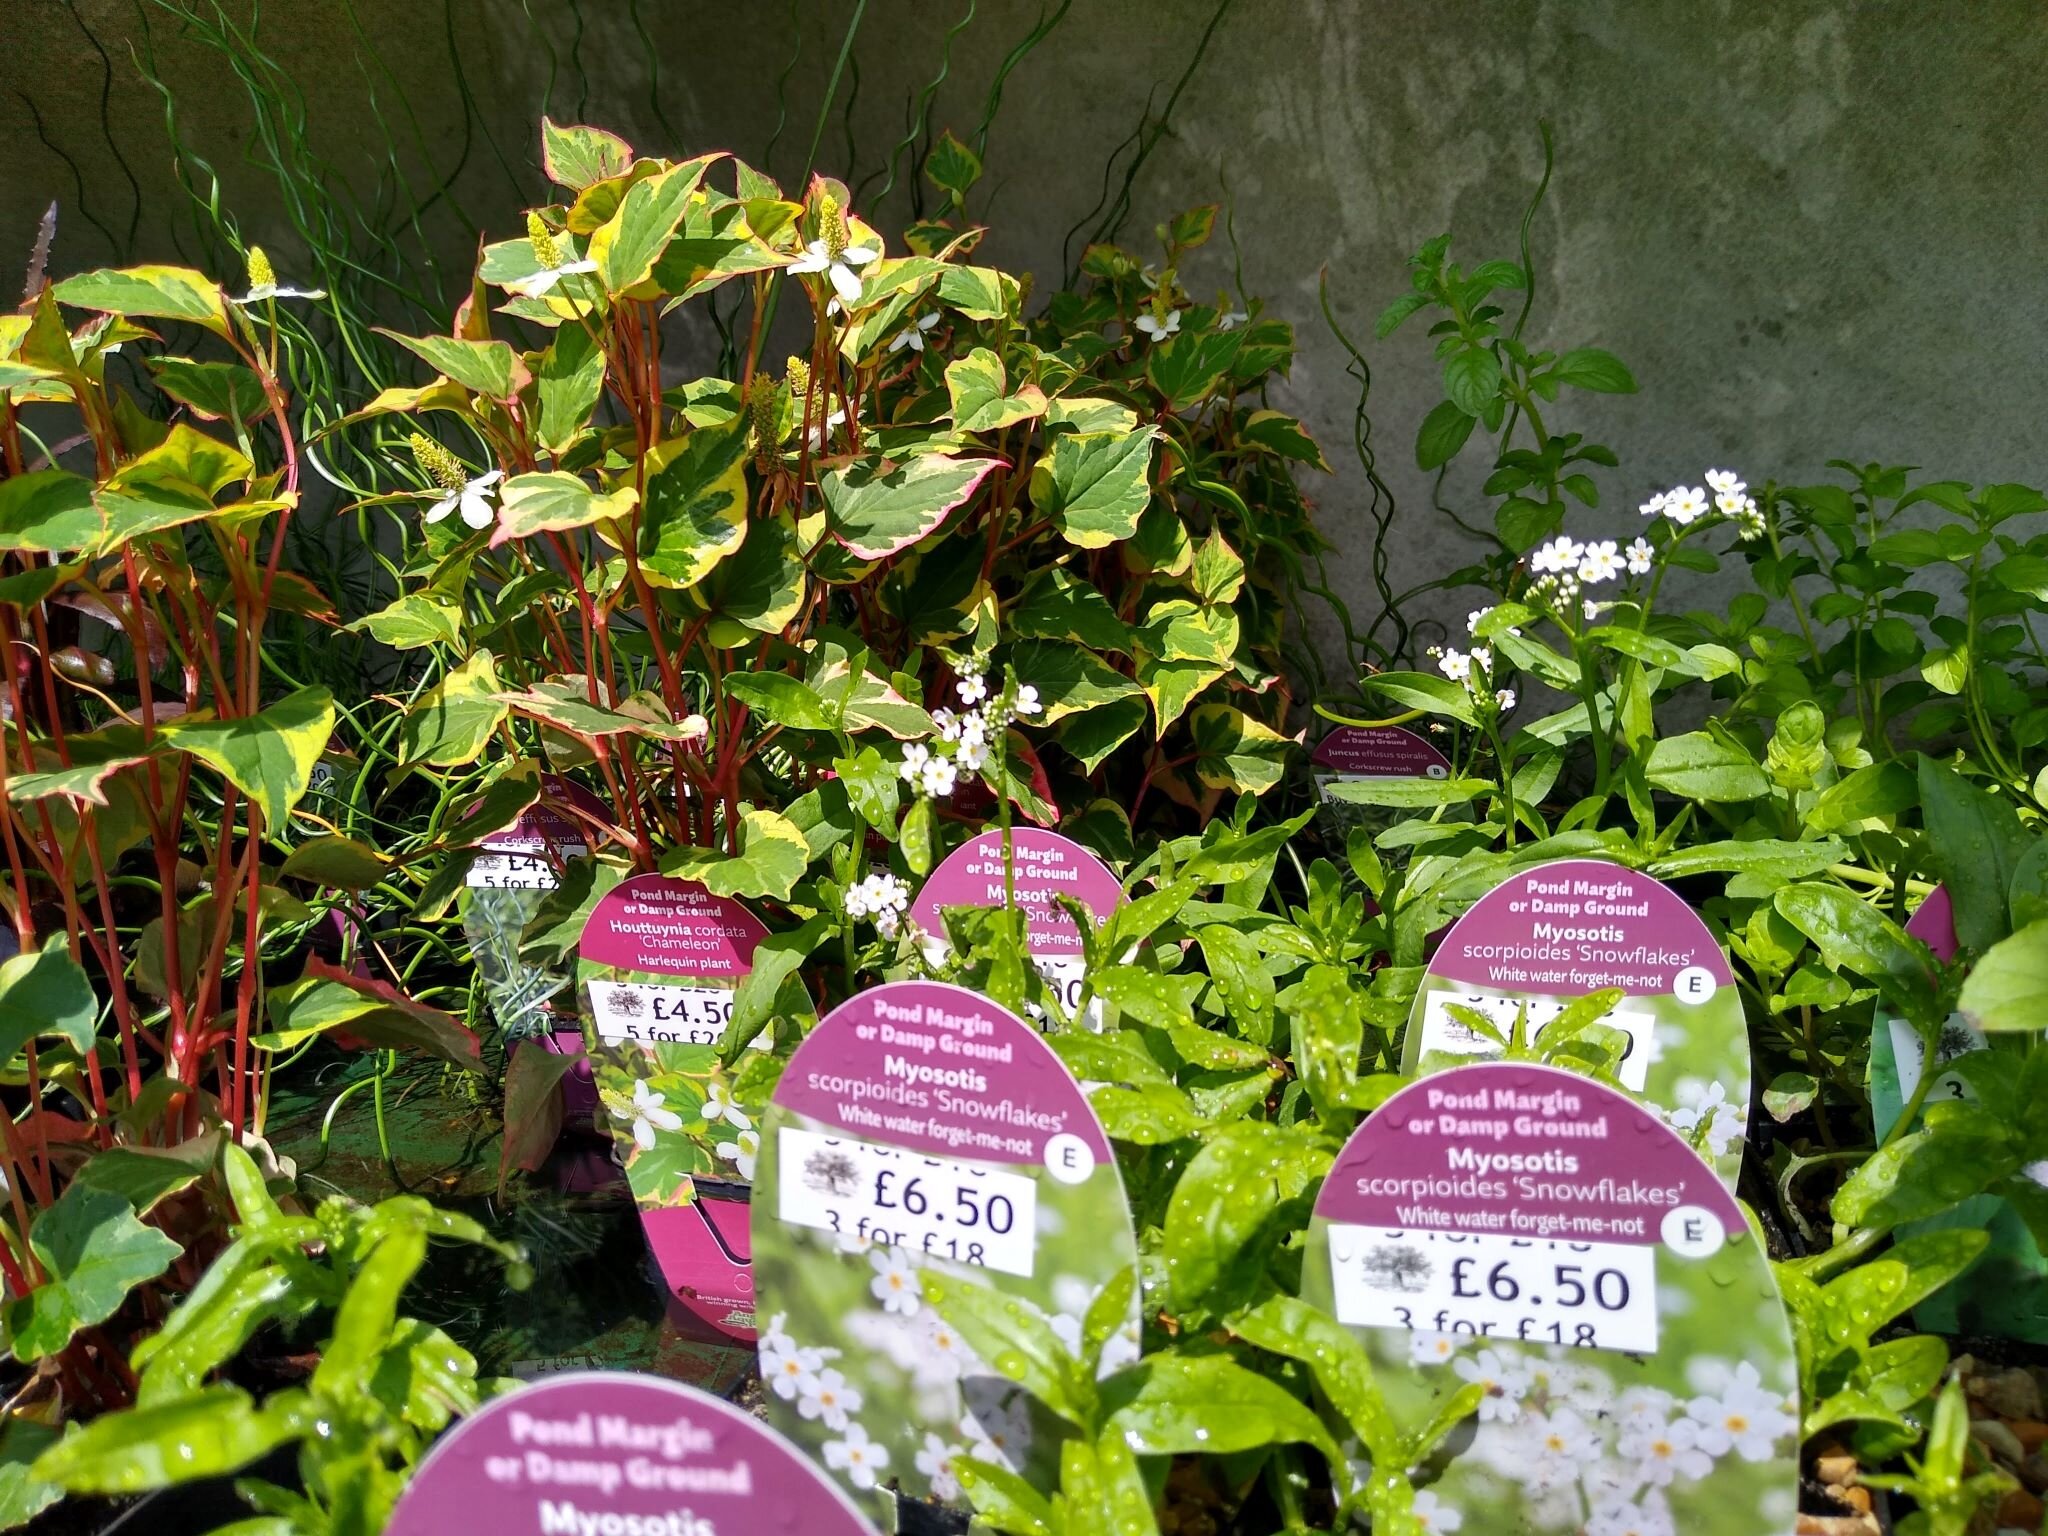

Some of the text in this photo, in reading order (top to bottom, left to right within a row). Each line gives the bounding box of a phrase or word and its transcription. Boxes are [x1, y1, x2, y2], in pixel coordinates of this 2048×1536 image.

[1347, 730, 1398, 739] Pond Margin
[1352, 738, 1375, 746] Damp
[1376, 739, 1407, 747] Ground
[1328, 749, 1428, 761] Juncus effusus spiralis
[1349, 762, 1412, 773] Corkscrew rush
[1433, 768, 1440, 776] B
[560, 834, 581, 844] rush
[1016, 846, 1064, 866] Margin
[503, 877, 530, 889] for
[966, 864, 981, 874] or
[1026, 864, 1078, 882] Ground
[631, 889, 707, 904] Pond Margin
[1526, 880, 1634, 900] Pond Margin
[623, 903, 722, 919] or Damp Ground
[1508, 899, 1650, 917] or Damp Ground
[610, 919, 747, 938] Houttuynia cordata
[1532, 923, 1625, 945] Myosotis
[638, 953, 731, 970] Harlequin plant
[1463, 943, 1571, 964] scorpioides
[1488, 966, 1663, 989] White water forget-me-not
[1688, 976, 1702, 993] E
[874, 999, 923, 1025] Pond
[925, 1005, 994, 1037] Margin
[627, 1025, 640, 1039] 5
[648, 1026, 680, 1043] for
[856, 1023, 1012, 1063] or Damp Ground
[883, 1055, 987, 1093] Myosotis
[808, 1072, 929, 1110] scorpioides
[1428, 1089, 1581, 1115] Pond Margin
[838, 1103, 1032, 1157] White water forget-me-not
[1408, 1115, 1608, 1138] or Damp Ground
[1062, 1147, 1076, 1168] E
[1447, 1146, 1579, 1176] Myosotis
[1356, 1176, 1507, 1203] scorpioides
[874, 1170, 1014, 1235] £6.50
[1396, 1206, 1645, 1236] White water forget-me-not
[1684, 1219, 1704, 1242] E
[825, 1210, 986, 1267] 3 for £18
[1450, 1256, 1630, 1311] £6.50
[1393, 1306, 1597, 1349] 3 for £18
[508, 1411, 713, 1461] Pond Margin
[485, 1450, 753, 1496] or Damp Ground
[538, 1499, 716, 1536] Myosotis
